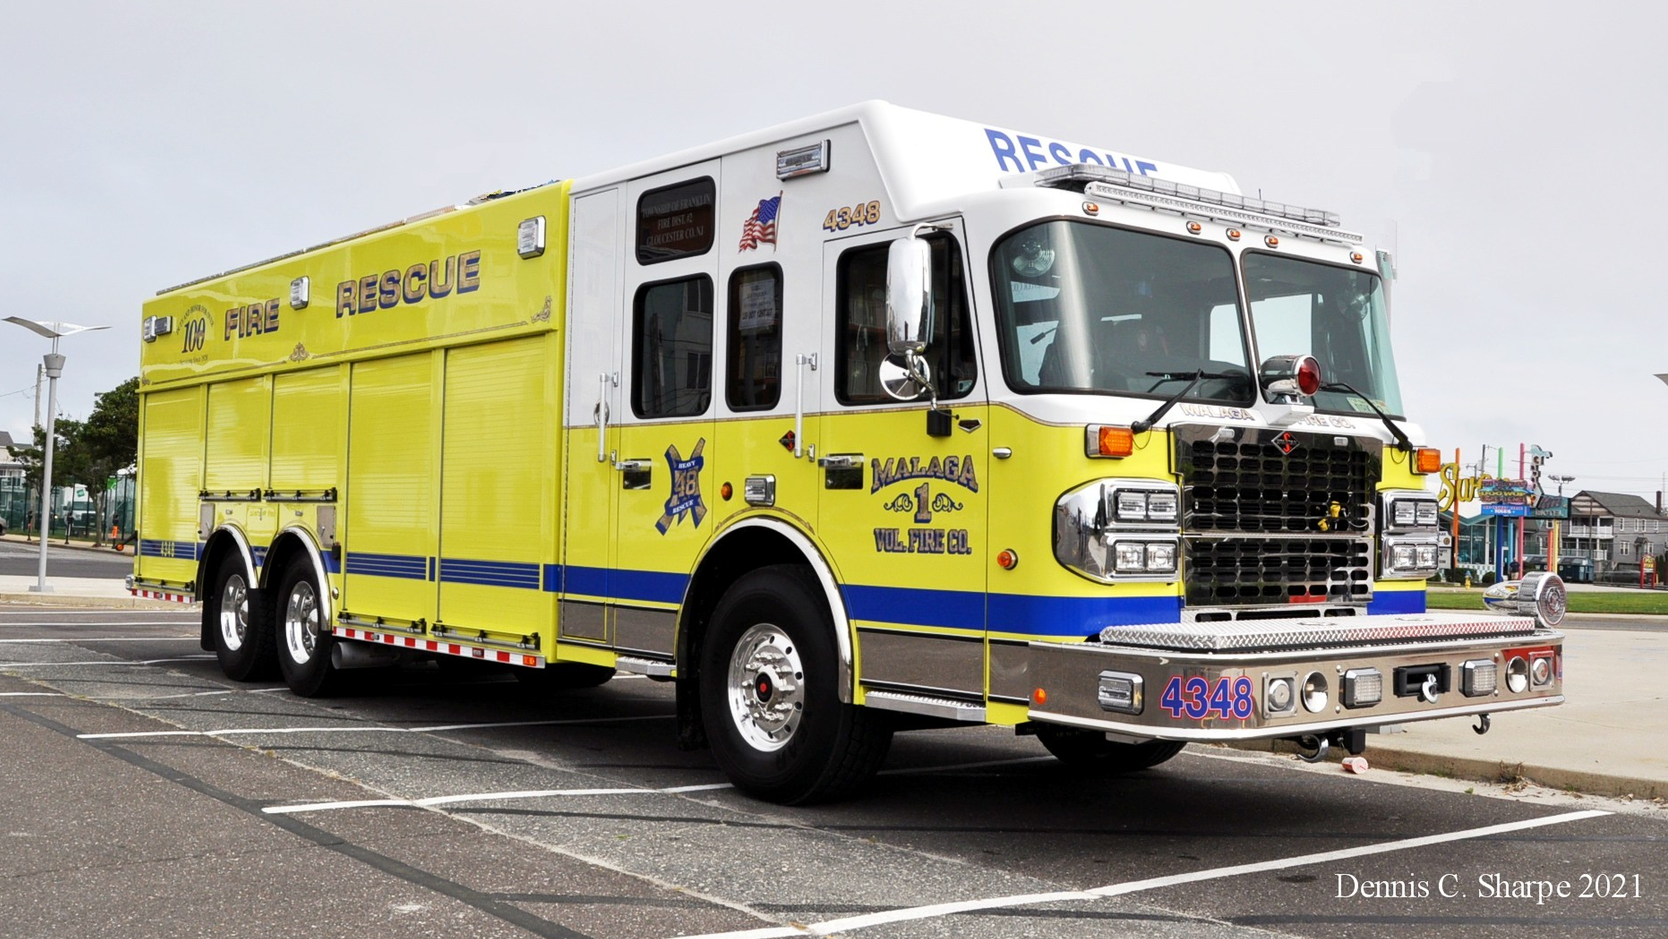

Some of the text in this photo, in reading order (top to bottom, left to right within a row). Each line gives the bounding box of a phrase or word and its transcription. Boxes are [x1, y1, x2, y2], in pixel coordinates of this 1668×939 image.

[671, 201, 679, 211] OF
[823, 200, 880, 232] 4348
[658, 217, 670, 230] FIRE
[646, 229, 684, 247] GLOUCESTER
[224, 297, 280, 342] FIRE
[336, 250, 481, 319] RESCUE
[182, 317, 206, 353] 100
[1180, 404, 1255, 421] MALAGA
[1298, 415, 1329, 427] IRE
[678, 460, 696, 469] HEAVY
[871, 455, 978, 495] MALAGA
[674, 468, 697, 497] 48
[672, 499, 694, 514] RESCUE
[914, 482, 932, 523] 1
[873, 528, 972, 555] VOL. FIRE CO.
[1159, 675, 1253, 721] 4348
